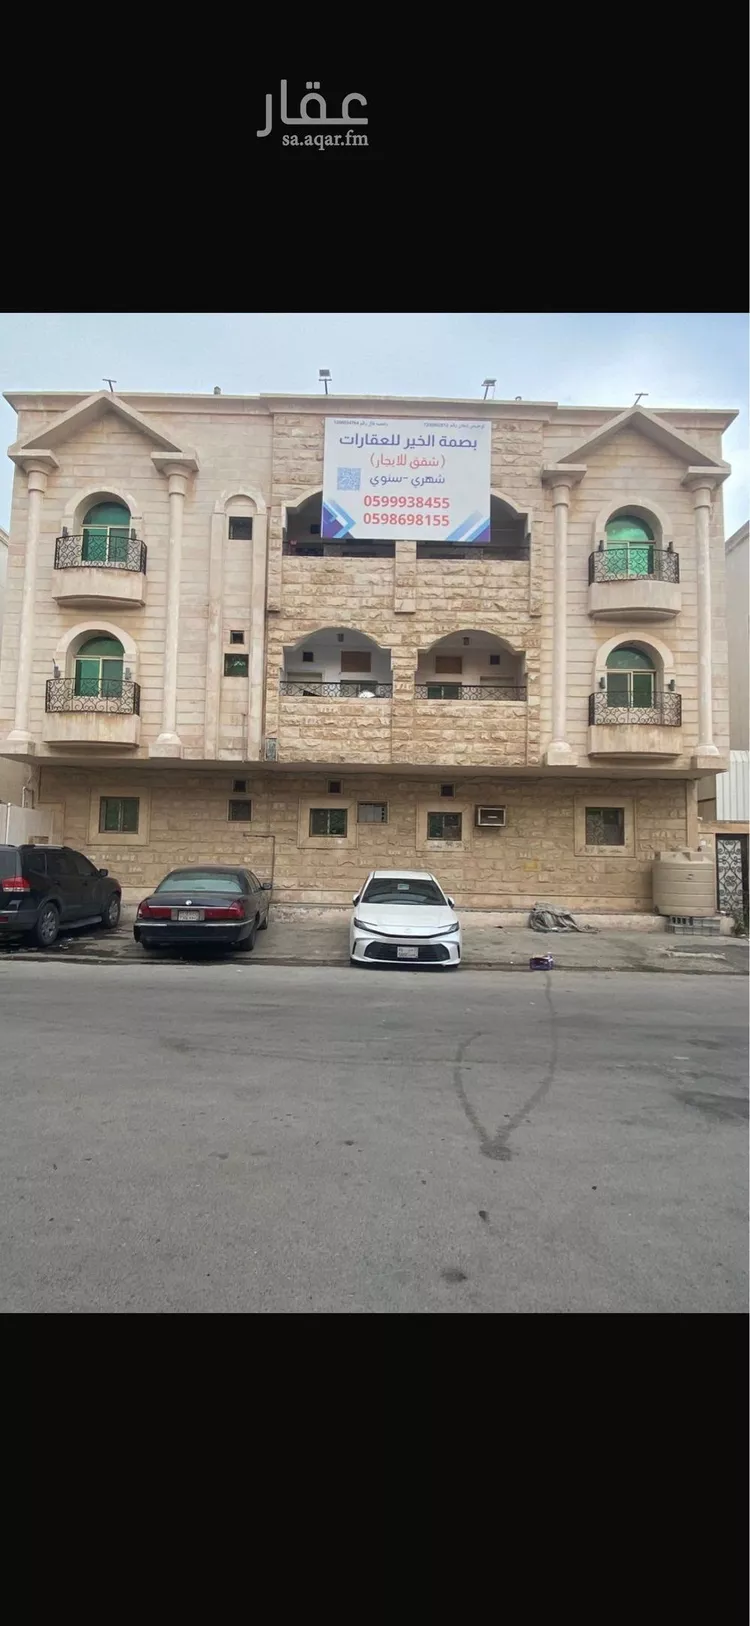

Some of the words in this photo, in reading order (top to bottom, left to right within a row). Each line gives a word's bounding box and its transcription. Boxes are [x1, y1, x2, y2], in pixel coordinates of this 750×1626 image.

[339, 433, 400, 449] للعقارات
[403, 434, 435, 450] الخير
[439, 435, 477, 450] بصمة
[411, 474, 445, 489] شهري
[363, 495, 450, 509] 0599938455
[363, 513, 450, 527] 0598698155
